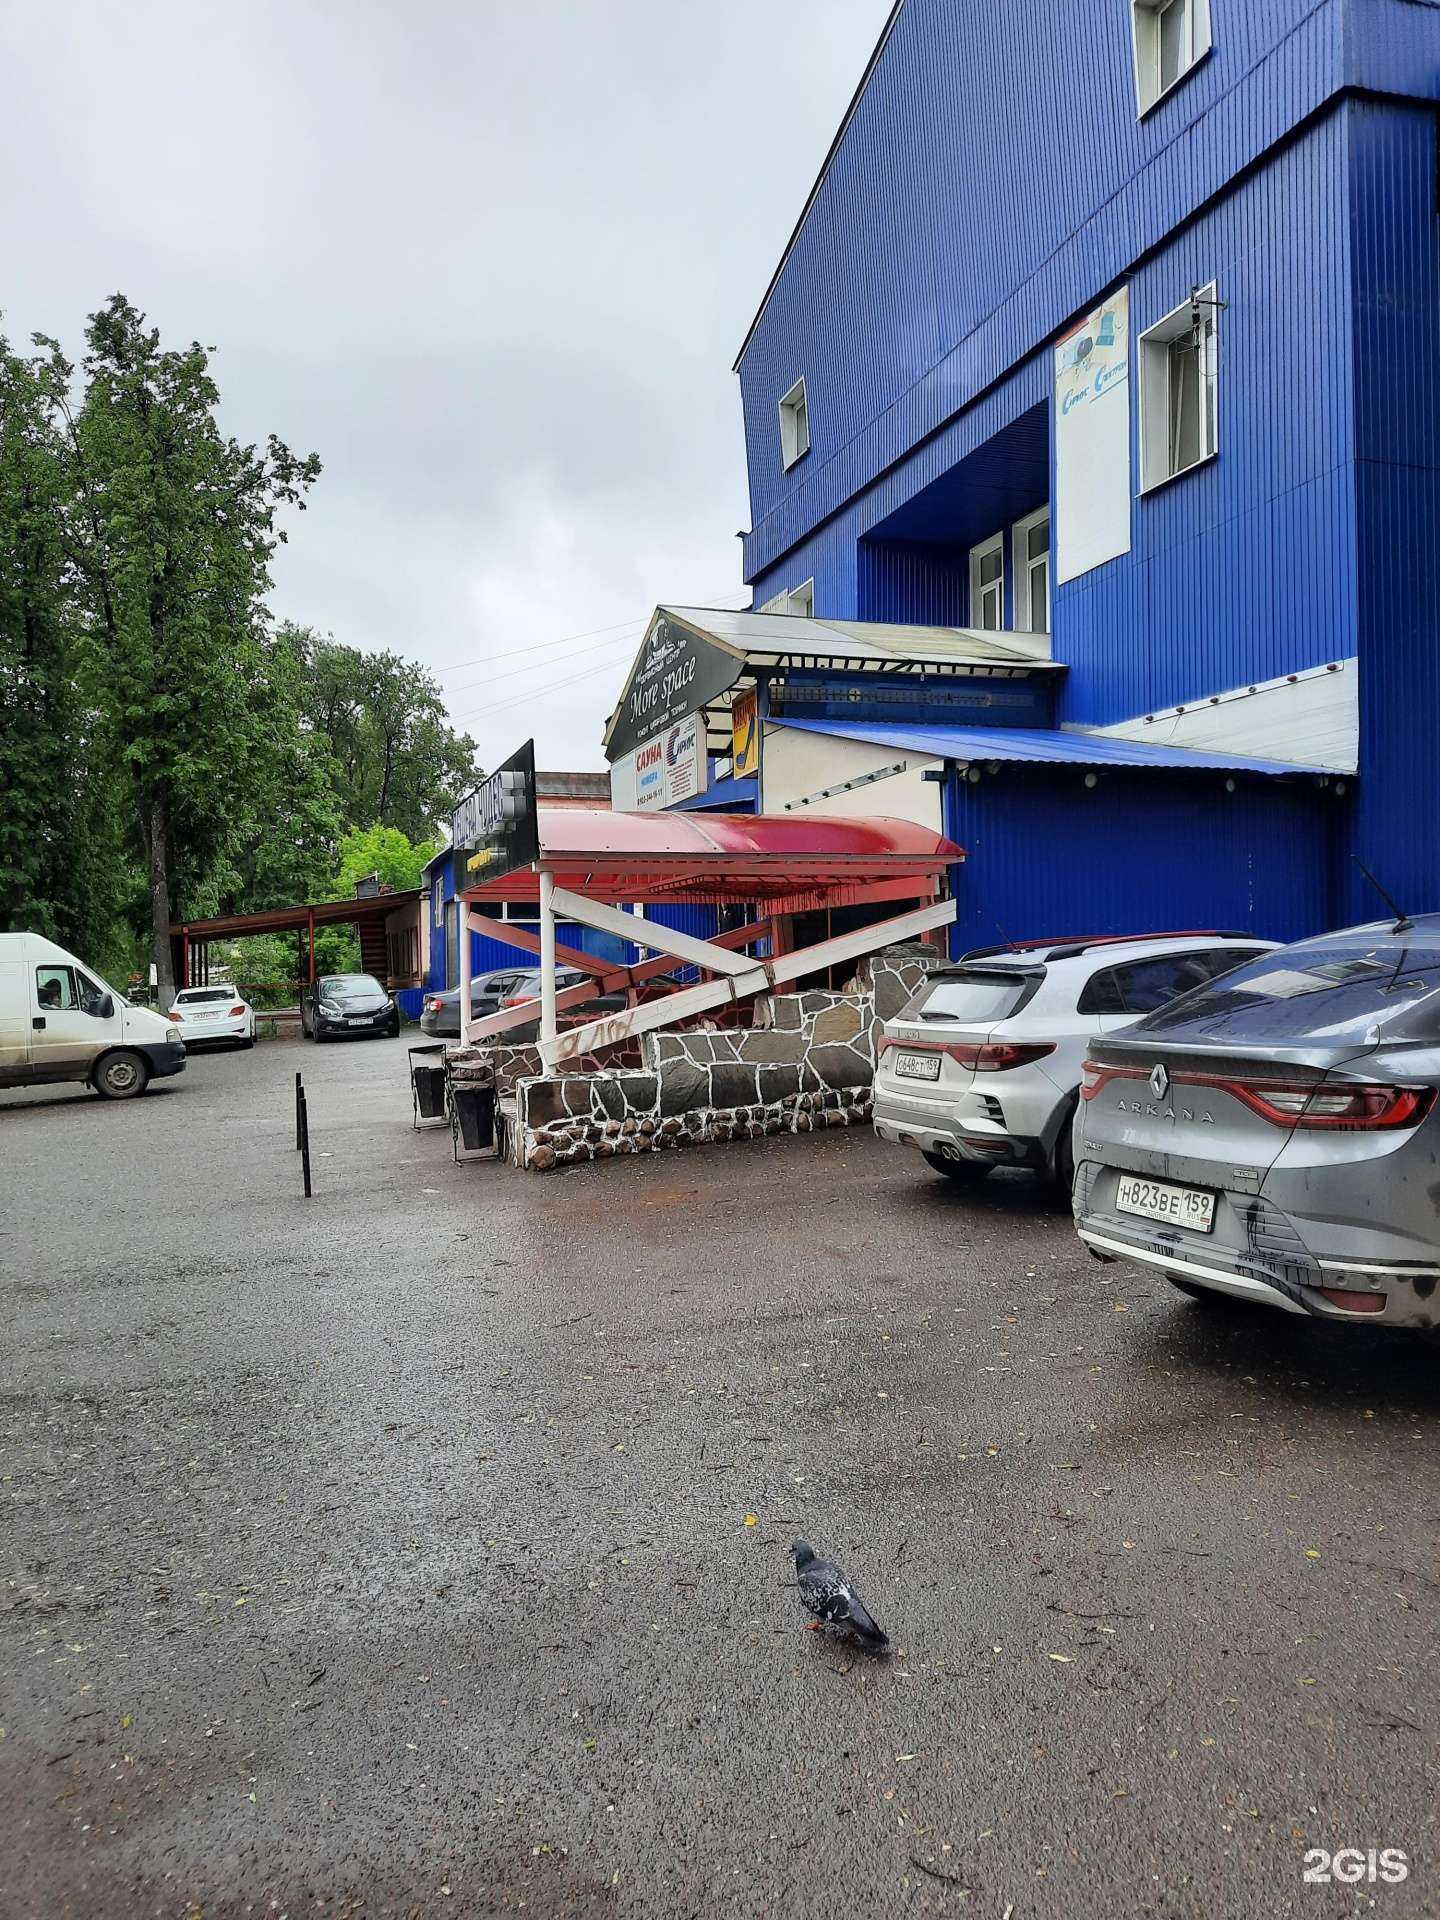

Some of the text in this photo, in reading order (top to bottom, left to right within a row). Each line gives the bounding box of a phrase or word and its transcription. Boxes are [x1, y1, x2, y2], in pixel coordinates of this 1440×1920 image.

[630, 656, 696, 723] More space
[636, 741, 662, 772] САУНА
[926, 1060, 938, 1072] 159
[1117, 1099, 1216, 1124] ARKANA
[1121, 1183, 1180, 1215] Н823ВЕ
[1184, 1192, 1210, 1215] 159
